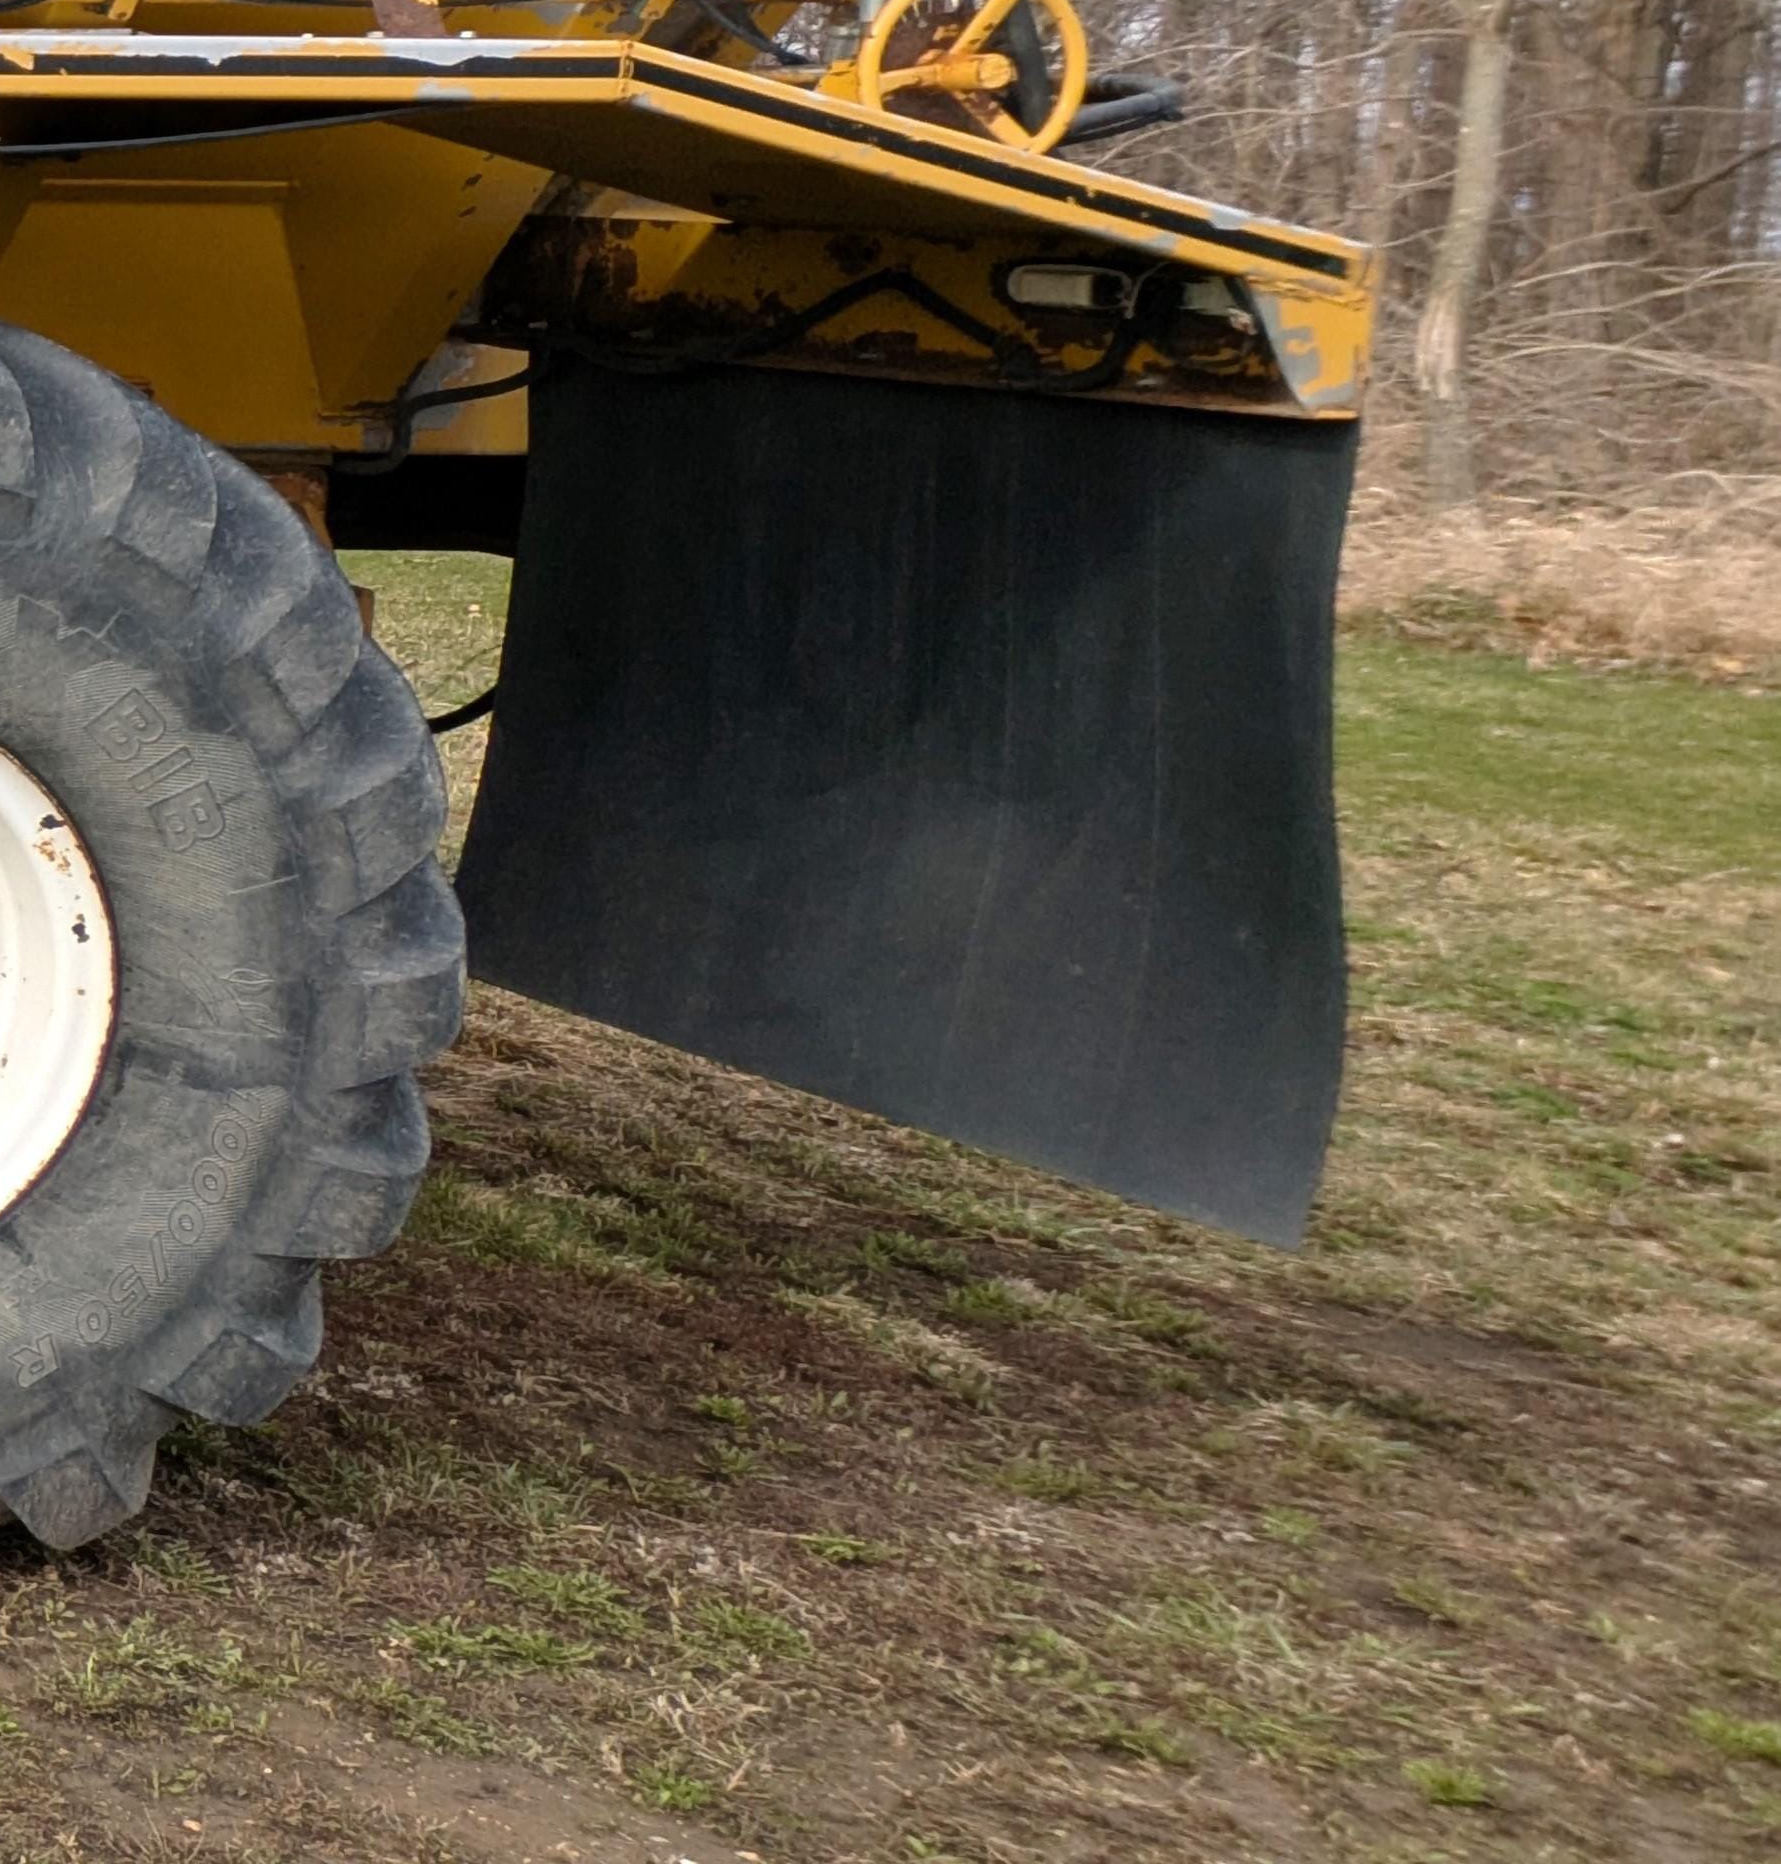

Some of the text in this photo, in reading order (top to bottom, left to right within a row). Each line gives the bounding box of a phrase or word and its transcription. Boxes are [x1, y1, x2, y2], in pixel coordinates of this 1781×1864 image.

[83, 687, 226, 852] BIB
[75, 1087, 263, 1344] 1000/50
[9, 1334, 58, 1387] R
